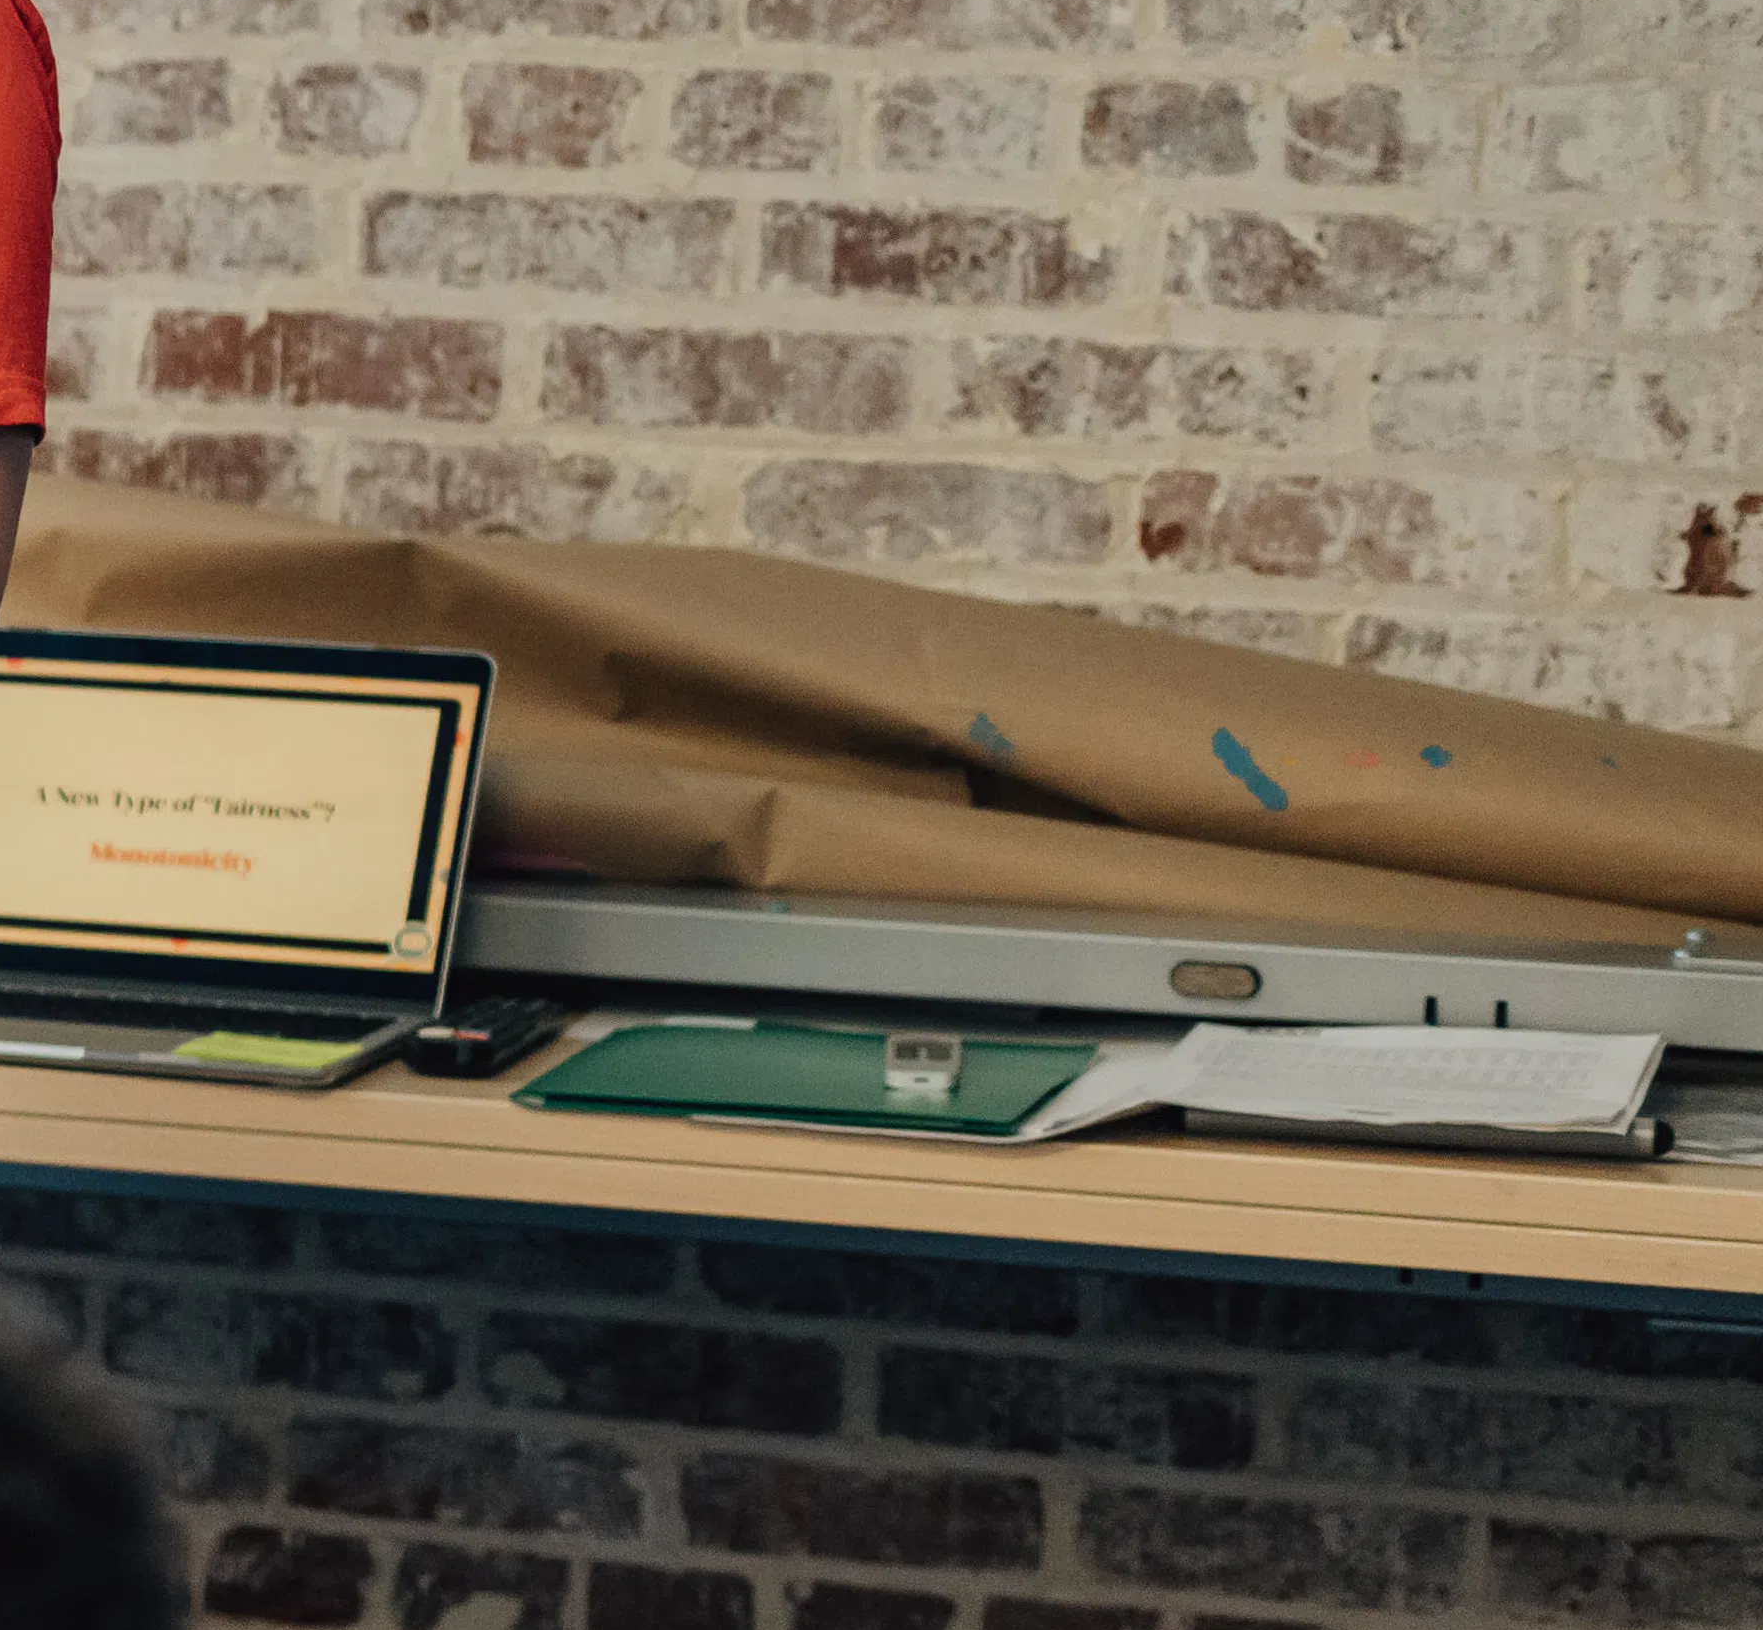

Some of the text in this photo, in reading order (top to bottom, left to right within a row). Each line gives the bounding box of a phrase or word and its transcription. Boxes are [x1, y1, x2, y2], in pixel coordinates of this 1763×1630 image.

[56, 785, 101, 806] New
[112, 789, 168, 815] Type
[171, 793, 199, 813] of
